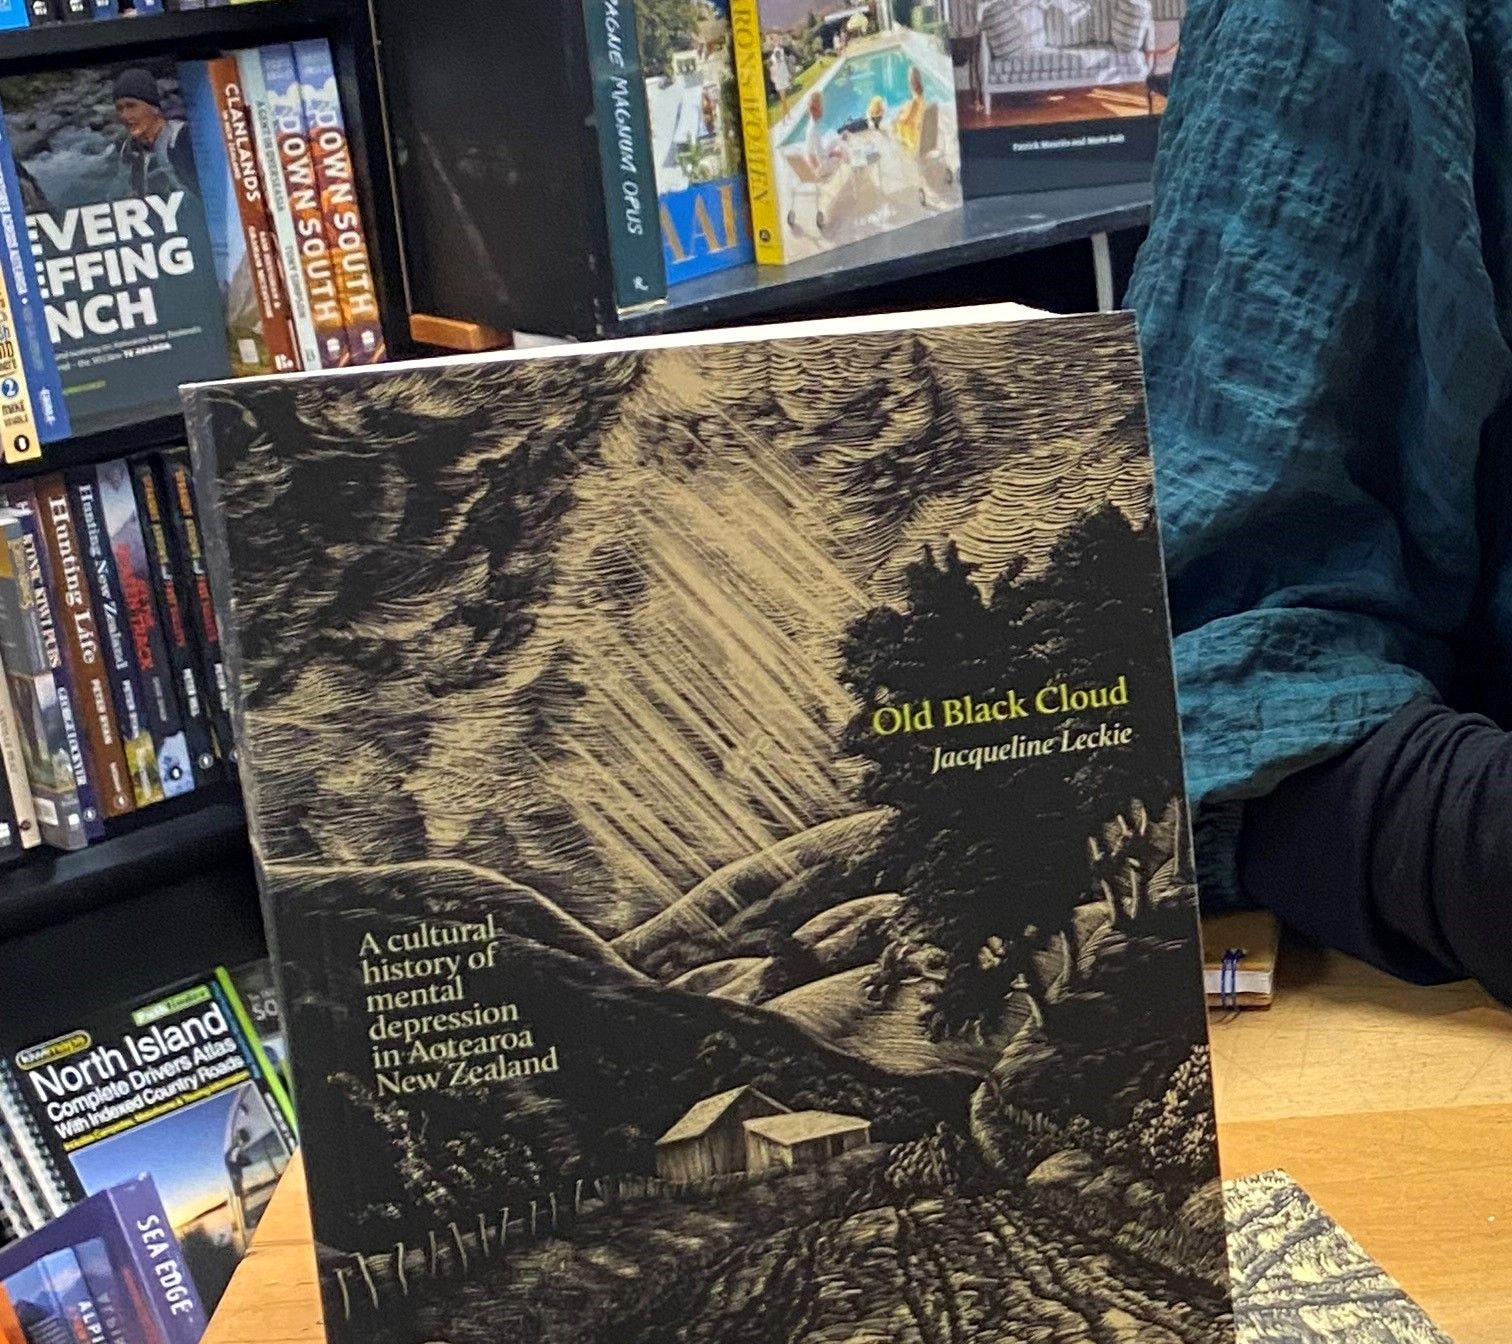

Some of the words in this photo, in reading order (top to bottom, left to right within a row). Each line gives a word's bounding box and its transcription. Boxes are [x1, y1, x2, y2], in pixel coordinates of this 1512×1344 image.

[223, 81, 262, 203] CLANLANDS
[314, 108, 354, 206] DOWN
[609, 75, 636, 174] MAGNUM
[623, 178, 644, 236] OPUS
[278, 113, 318, 210] DOWN
[298, 217, 339, 323] SOUTH
[333, 210, 373, 316] SOUTH
[43, 286, 158, 344] NCH
[78, 484, 101, 558] Hunting
[48, 494, 84, 607] Hunting
[74, 610, 95, 665] Life
[94, 558, 113, 601] New
[103, 601, 128, 671] Zealand
[871, 698, 935, 736] Old
[941, 689, 1030, 728] Black
[1034, 674, 1130, 715] Cloud
[931, 734, 1060, 775] Jacqueline
[1060, 722, 1134, 753] Leckie
[358, 931, 382, 957] A
[387, 913, 498, 953] cultural
[361, 955, 462, 985] history
[467, 941, 499, 970] of
[366, 974, 465, 1013] mental
[368, 1002, 520, 1044] depression
[28, 1045, 128, 1103] North
[123, 1001, 229, 1067] Island
[46, 1080, 130, 1123] Complete
[129, 1055, 193, 1090] Drivers
[193, 1037, 238, 1065] Atlas
[371, 1045, 401, 1069] in
[408, 1028, 535, 1064] Aotearoa
[376, 1069, 441, 1097] New
[448, 1045, 560, 1088] Zealand
[54, 1114, 90, 1140] With
[89, 1094, 145, 1127] Indexed
[142, 1072, 199, 1109] Country
[198, 1054, 246, 1083] Roads
[136, 1213, 169, 1262] SEA
[154, 1263, 195, 1317] EDGE
